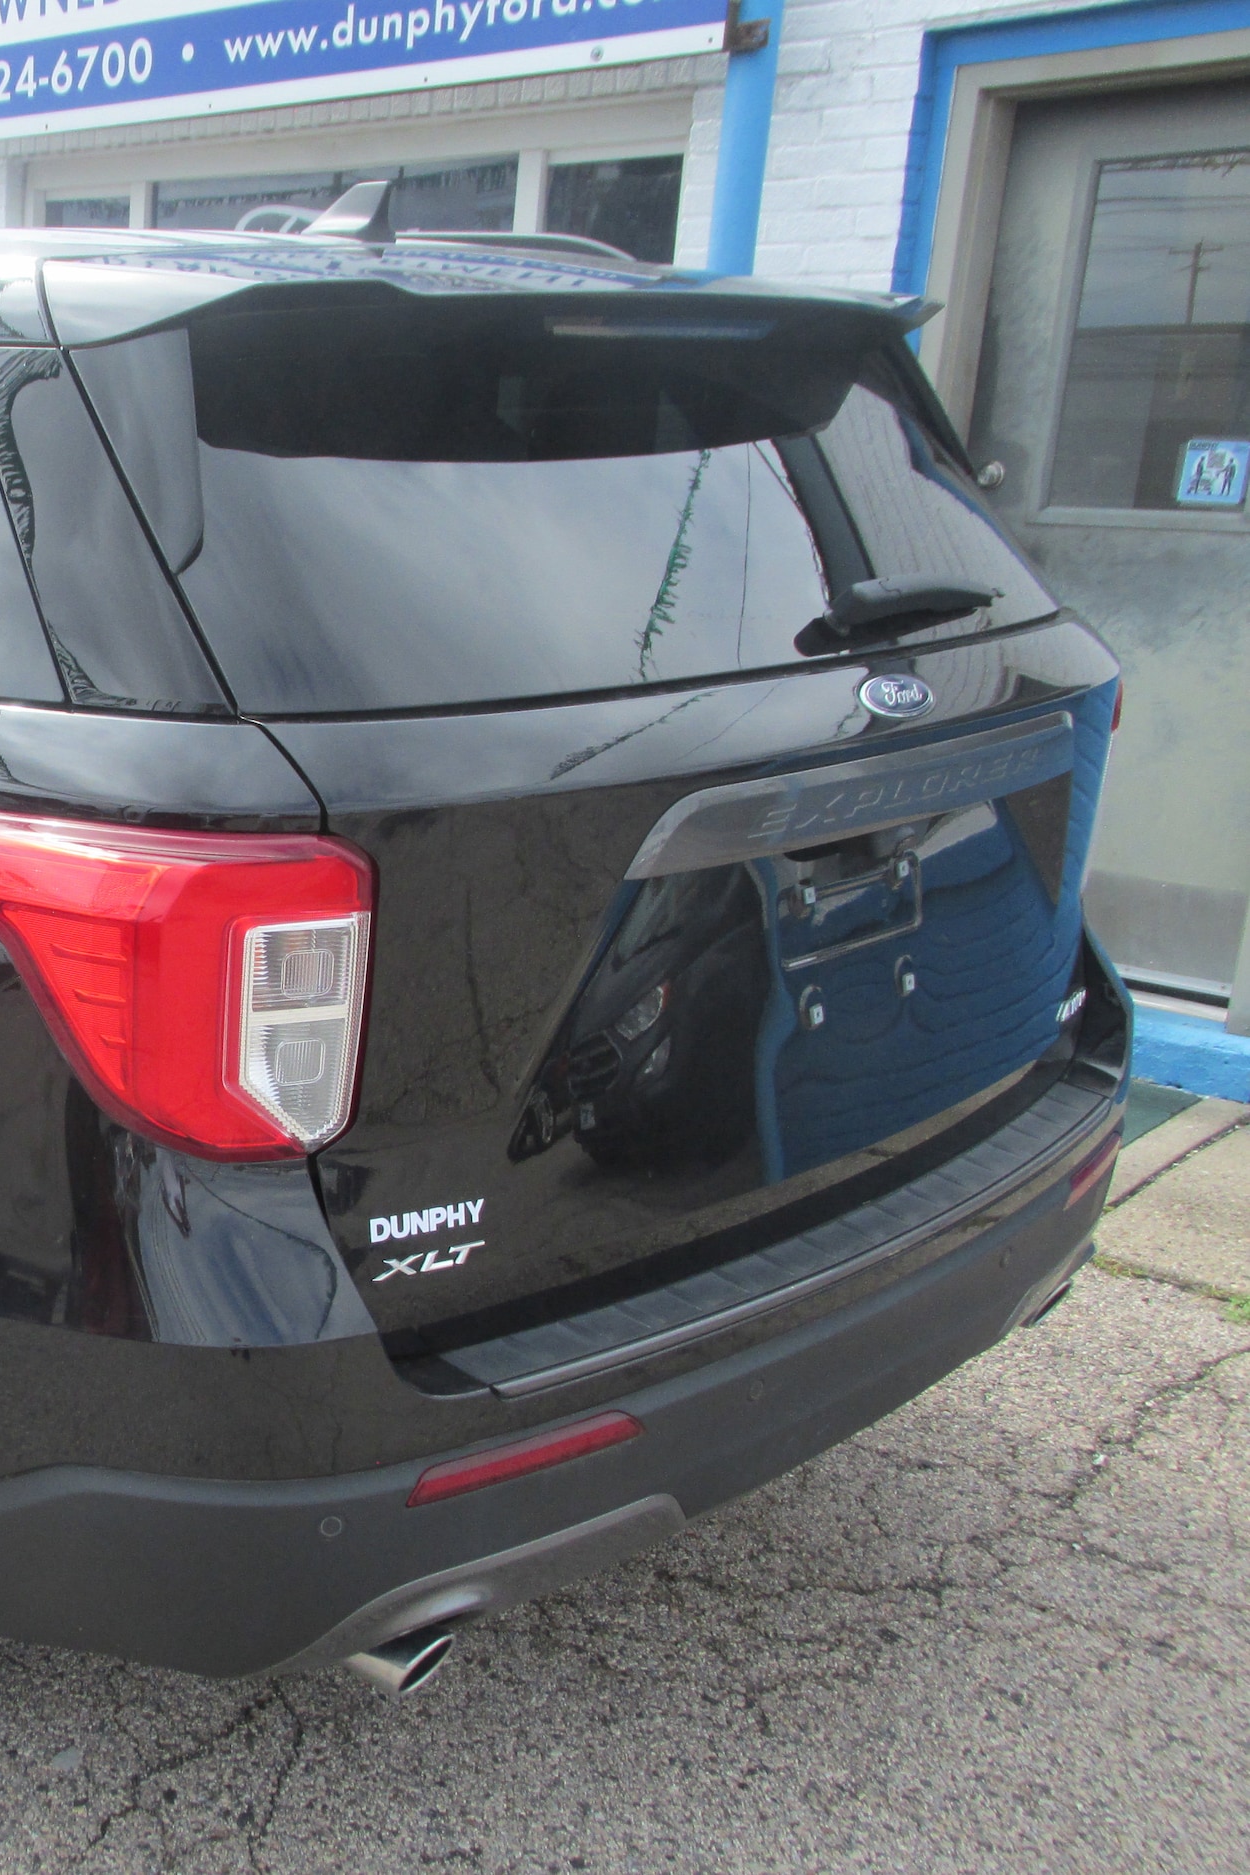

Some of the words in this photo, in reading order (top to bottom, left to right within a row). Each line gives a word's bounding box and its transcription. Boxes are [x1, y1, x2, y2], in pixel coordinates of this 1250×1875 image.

[224, 0, 661, 63] www.dunphyfor.
[881, 680, 923, 706] Ford
[748, 748, 1039, 838] EXPLORER
[369, 1198, 485, 1243] DUNPHY
[372, 1239, 486, 1282] XLT
